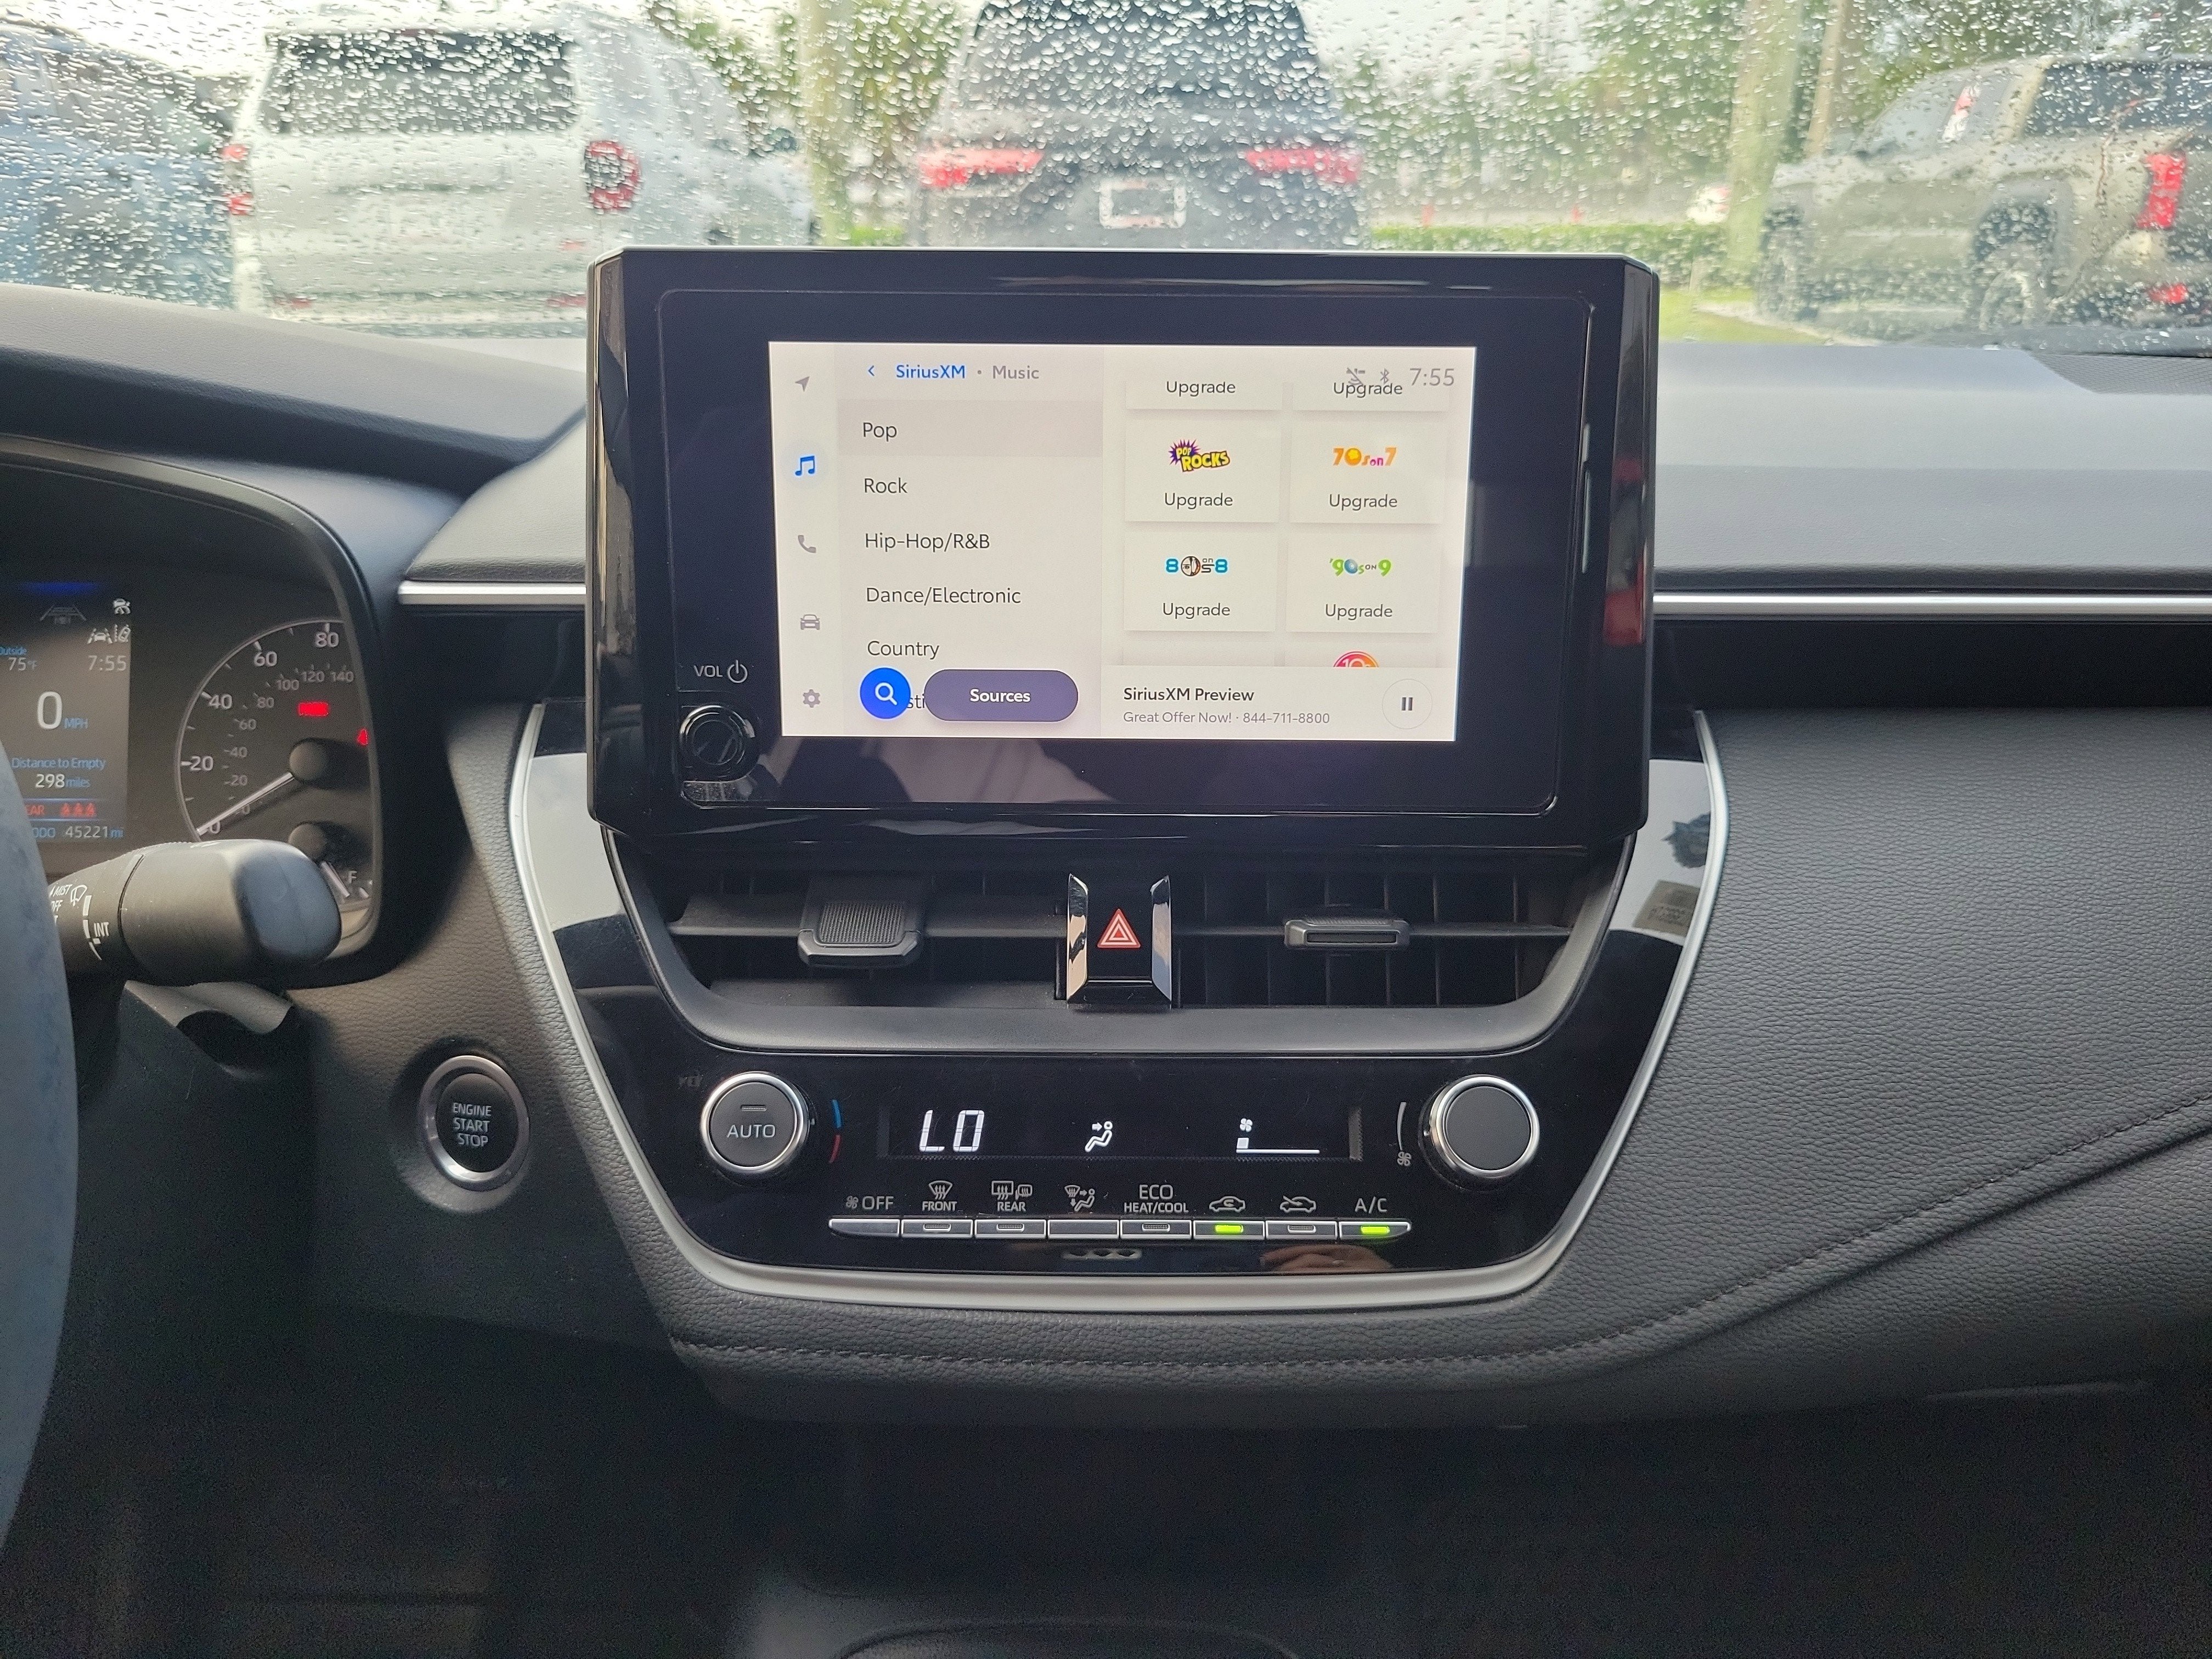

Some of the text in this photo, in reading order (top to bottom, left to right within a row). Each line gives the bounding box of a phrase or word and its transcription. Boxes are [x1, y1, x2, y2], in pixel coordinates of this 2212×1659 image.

[895, 365, 1040, 380] SiriusXM Music
[1409, 368, 1455, 386] 7:55
[1165, 381, 1237, 396] Upgrade
[1333, 382, 1403, 398] Upgrade
[862, 422, 898, 442] Pop
[1176, 447, 1192, 459] POP
[1384, 447, 1397, 466] 7
[1181, 450, 1231, 472] ROCKS
[864, 477, 908, 494] Rock
[1164, 493, 1233, 510] Upgrade
[1329, 494, 1398, 511] Upgrade
[865, 533, 990, 552] Hip-Hop/R&B
[1215, 558, 1228, 573] 8
[1378, 559, 1391, 577] 9
[867, 587, 1021, 606] Dance/Electronic
[1163, 602, 1231, 619] Upgrade
[1325, 604, 1393, 621] Upgrade
[315, 631, 339, 648] 80
[868, 641, 940, 659] Country
[88, 654, 127, 671] 7:55
[253, 651, 278, 667] 60
[302, 671, 325, 682] 120
[330, 671, 354, 682] 140
[694, 665, 723, 678] VOL
[276, 679, 300, 691] 100
[208, 693, 233, 709] 40
[970, 689, 1031, 703] Sources
[1124, 687, 1255, 701] SiriusXM Preview
[257, 696, 275, 708] 80
[37, 691, 63, 729] 0
[1124, 712, 1330, 724] Great Offer Now! 844-711-8800
[190, 755, 214, 771] 20
[35, 774, 65, 788] 298
[65, 825, 109, 838] 45221
[93, 922, 110, 937] INT
[453, 1102, 492, 1117] ENGINE
[453, 1118, 490, 1133] START
[726, 1124, 776, 1138] AUTO
[919, 1109, 985, 1152] LO
[456, 1133, 489, 1147] STOP
[1139, 1184, 1173, 1200] ECO
[862, 1196, 894, 1210] OFF
[922, 1201, 957, 1212] FRONT
[997, 1201, 1026, 1212] REAR
[1124, 1202, 1189, 1214] HEAT/COOL
[1355, 1196, 1388, 1213] A/C
